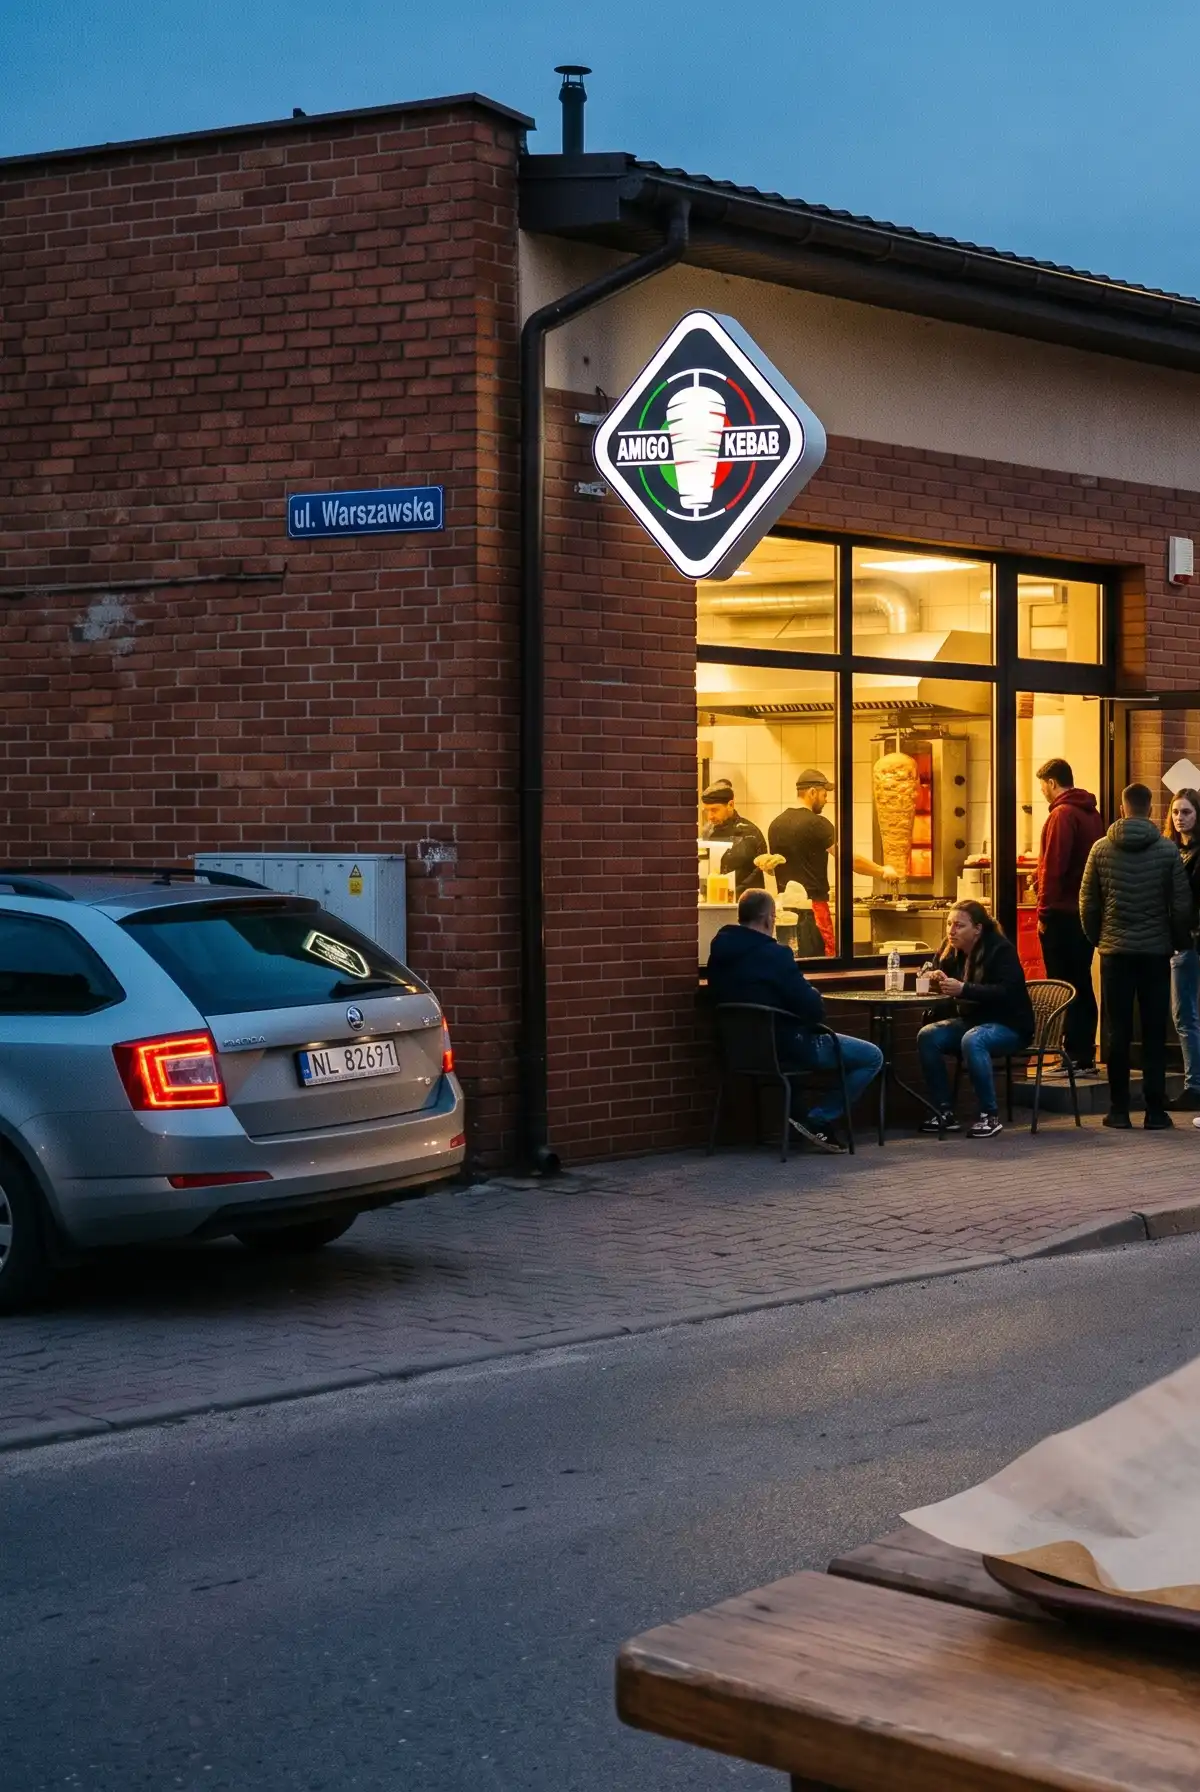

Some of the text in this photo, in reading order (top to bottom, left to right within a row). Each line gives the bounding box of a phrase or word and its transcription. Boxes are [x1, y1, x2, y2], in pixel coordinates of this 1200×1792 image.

[617, 434, 669, 461] AMIGO
[724, 428, 780, 457] KEBAB
[294, 495, 435, 528] ul. Warszawska
[312, 1051, 340, 1076] NL
[344, 1043, 394, 1071] 82691
